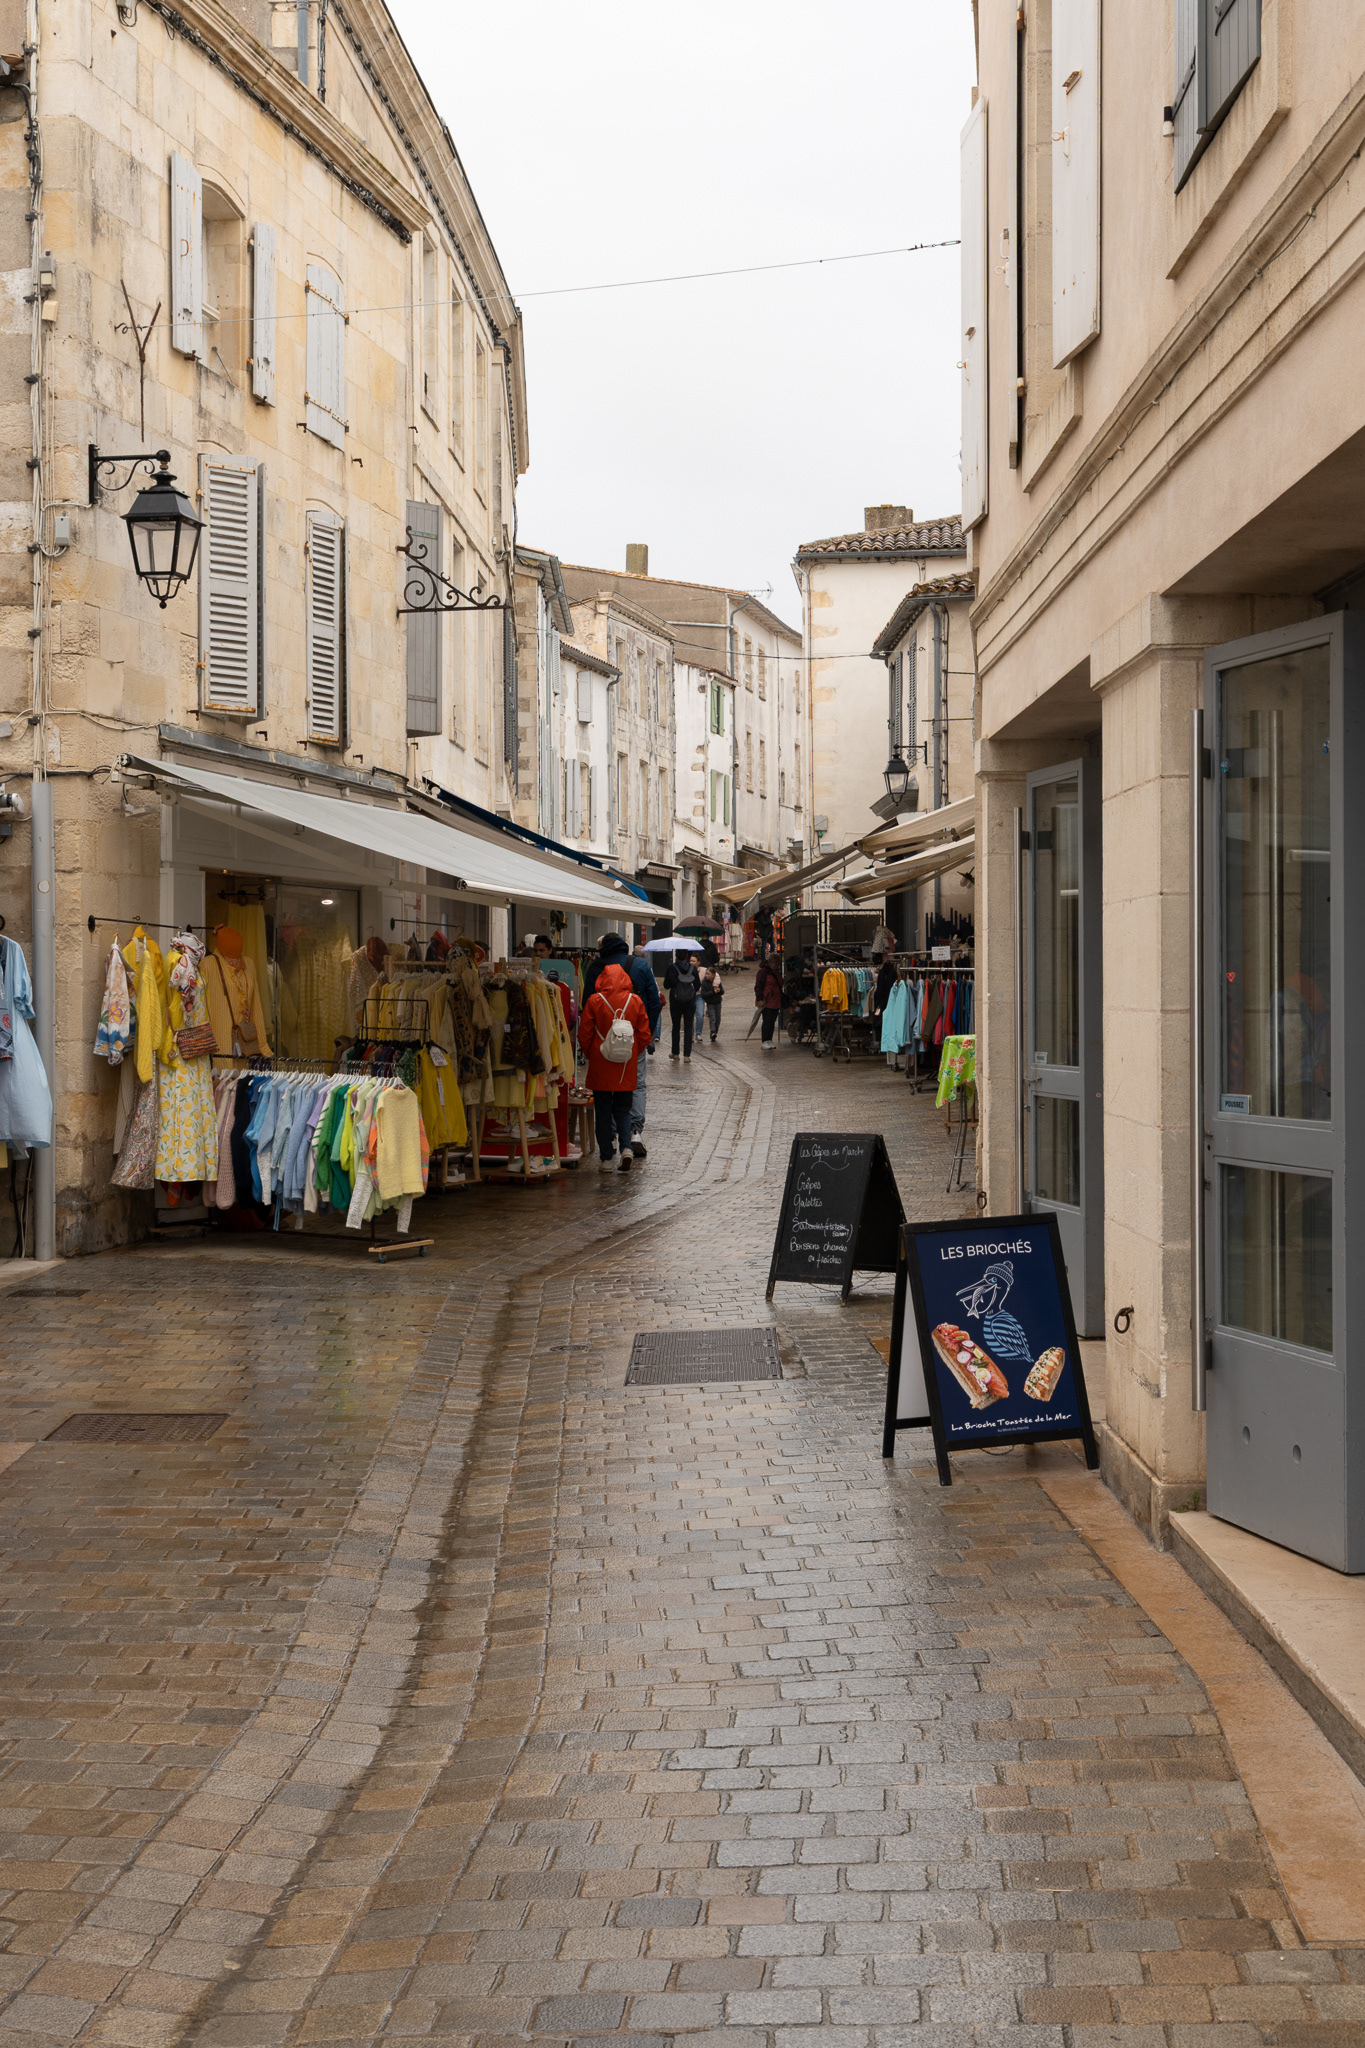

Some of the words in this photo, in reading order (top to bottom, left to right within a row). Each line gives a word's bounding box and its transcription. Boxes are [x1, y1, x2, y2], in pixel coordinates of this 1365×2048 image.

[1224, 1100, 1245, 1109] POUSSEZ
[800, 1145, 811, 1158] Les
[796, 1171, 822, 1195] Crêpes
[940, 1246, 964, 1260] LES
[966, 1238, 1032, 1257] BRIOCHÉS
[951, 1423, 963, 1431] La
[964, 1421, 997, 1430] Brioche
[997, 1417, 1033, 1426] Toastée
[1034, 1414, 1045, 1423] de
[1054, 1412, 1072, 1421] Mer
